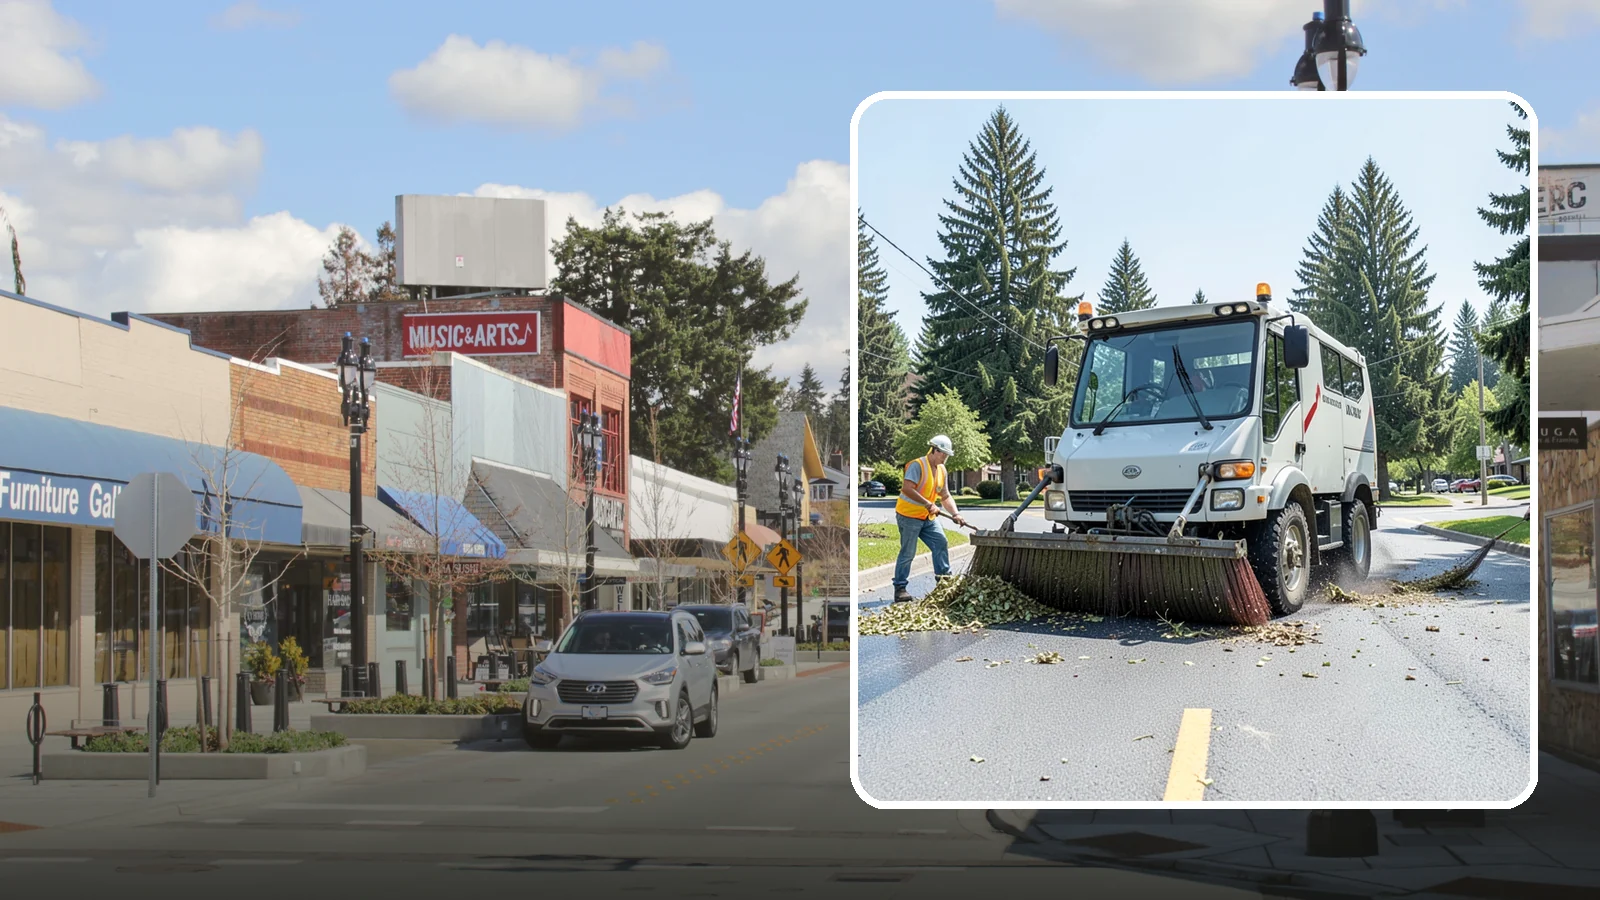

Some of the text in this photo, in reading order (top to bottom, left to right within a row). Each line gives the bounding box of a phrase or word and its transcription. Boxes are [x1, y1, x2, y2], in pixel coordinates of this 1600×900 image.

[1540, 427, 1577, 436] UGA
[0, 471, 121, 519] Furniture Gal
